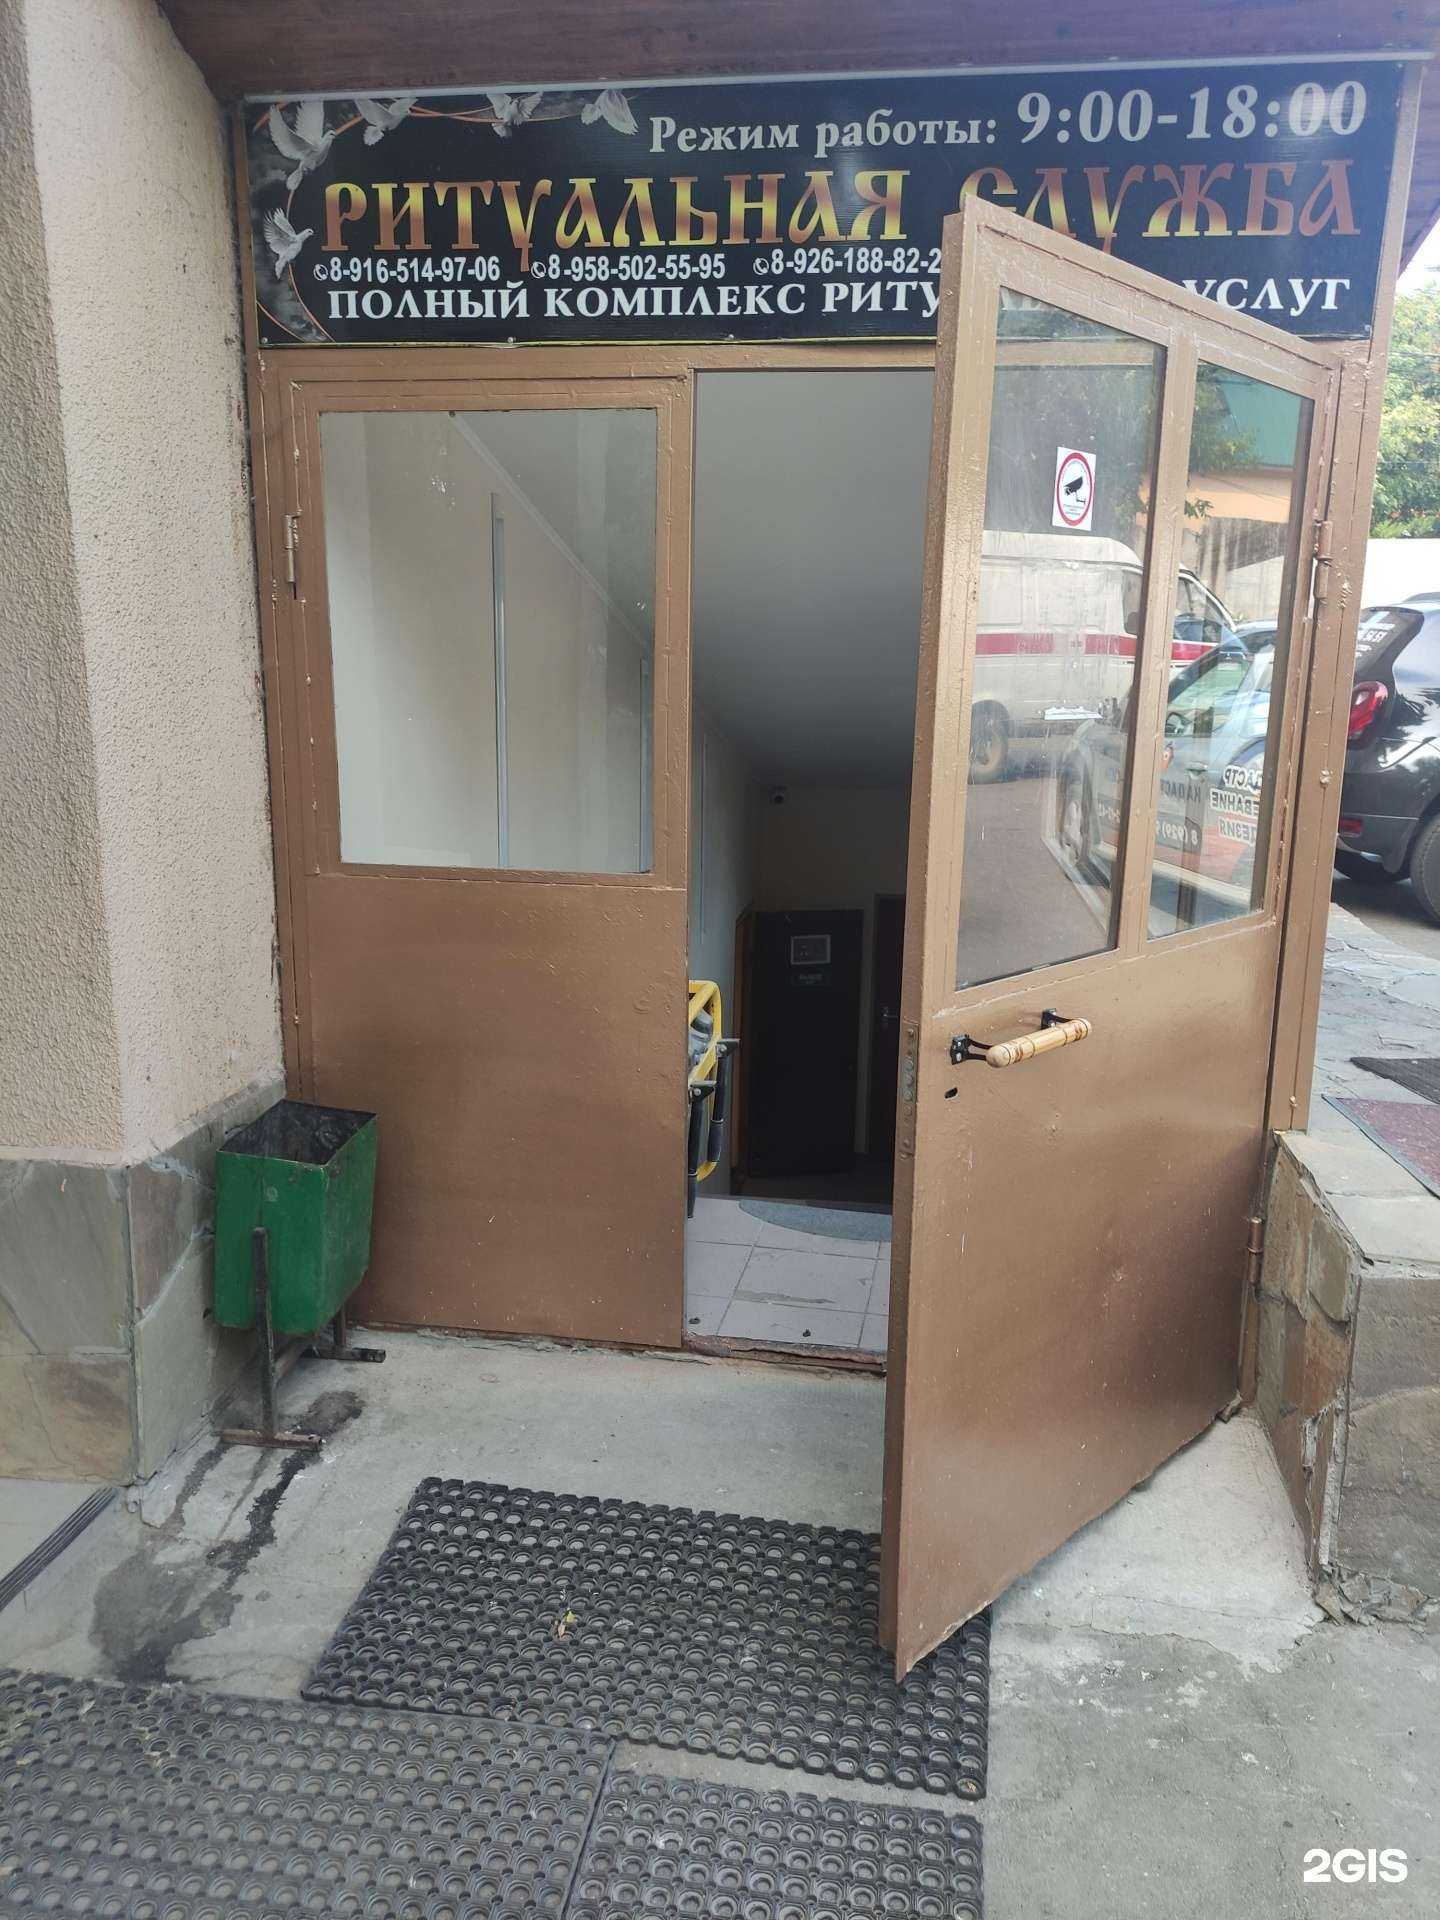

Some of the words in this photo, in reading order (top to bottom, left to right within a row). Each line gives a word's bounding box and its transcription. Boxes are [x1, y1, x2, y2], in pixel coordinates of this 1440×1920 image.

[649, 116, 800, 153] Режим
[814, 108, 997, 158] работы:
[1017, 80, 1367, 145] 9:00-18:00
[321, 169, 910, 272] РИТУАЛЬНАЯ
[958, 159, 1361, 254] СЛУЖБА
[329, 255, 501, 284] 8-916-514-97-06
[547, 253, 726, 282] 8-958-502-55-95
[771, 246, 942, 275] 8-926-188-82-2
[327, 280, 530, 320] ПОЛНЫЙ
[543, 283, 806, 318] КОМПЛЕКС
[821, 280, 941, 318] РИТУ
